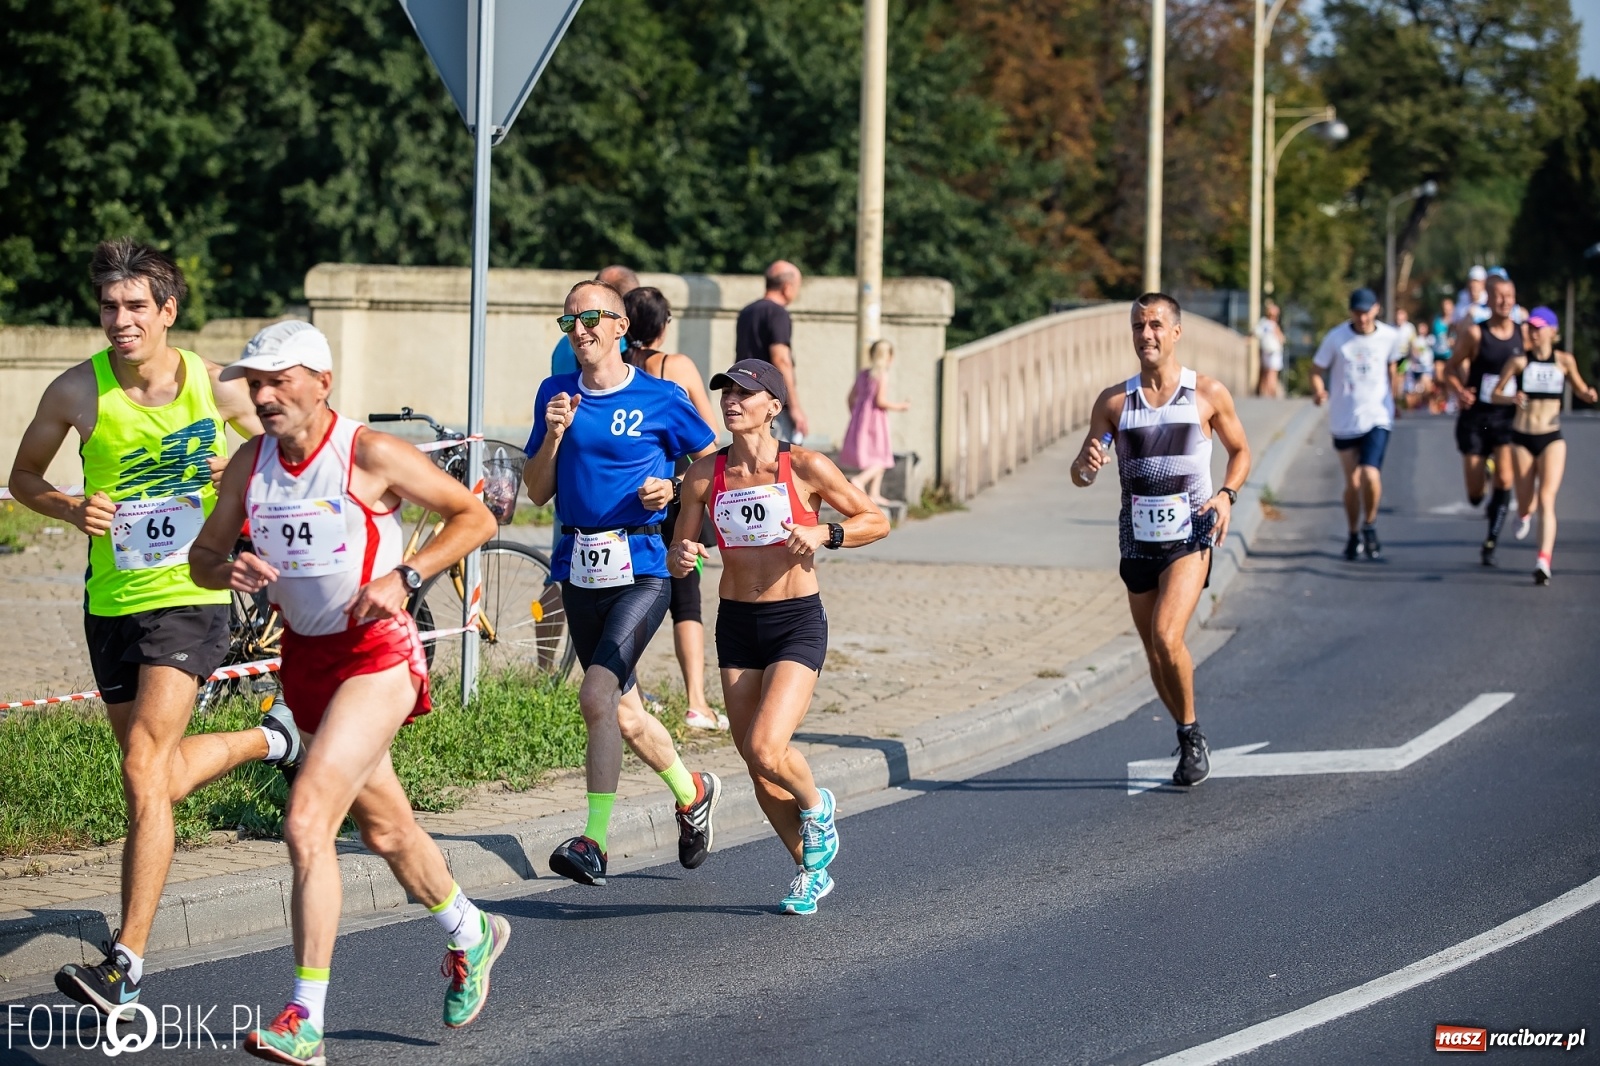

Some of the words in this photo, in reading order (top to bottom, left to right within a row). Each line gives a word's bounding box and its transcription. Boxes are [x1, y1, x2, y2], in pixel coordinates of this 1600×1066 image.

[611, 408, 644, 437] 82
[741, 503, 766, 524] 90
[1148, 508, 1175, 524] 155
[146, 516, 175, 540] 66
[281, 522, 313, 547] 94
[580, 547, 611, 567] 197
